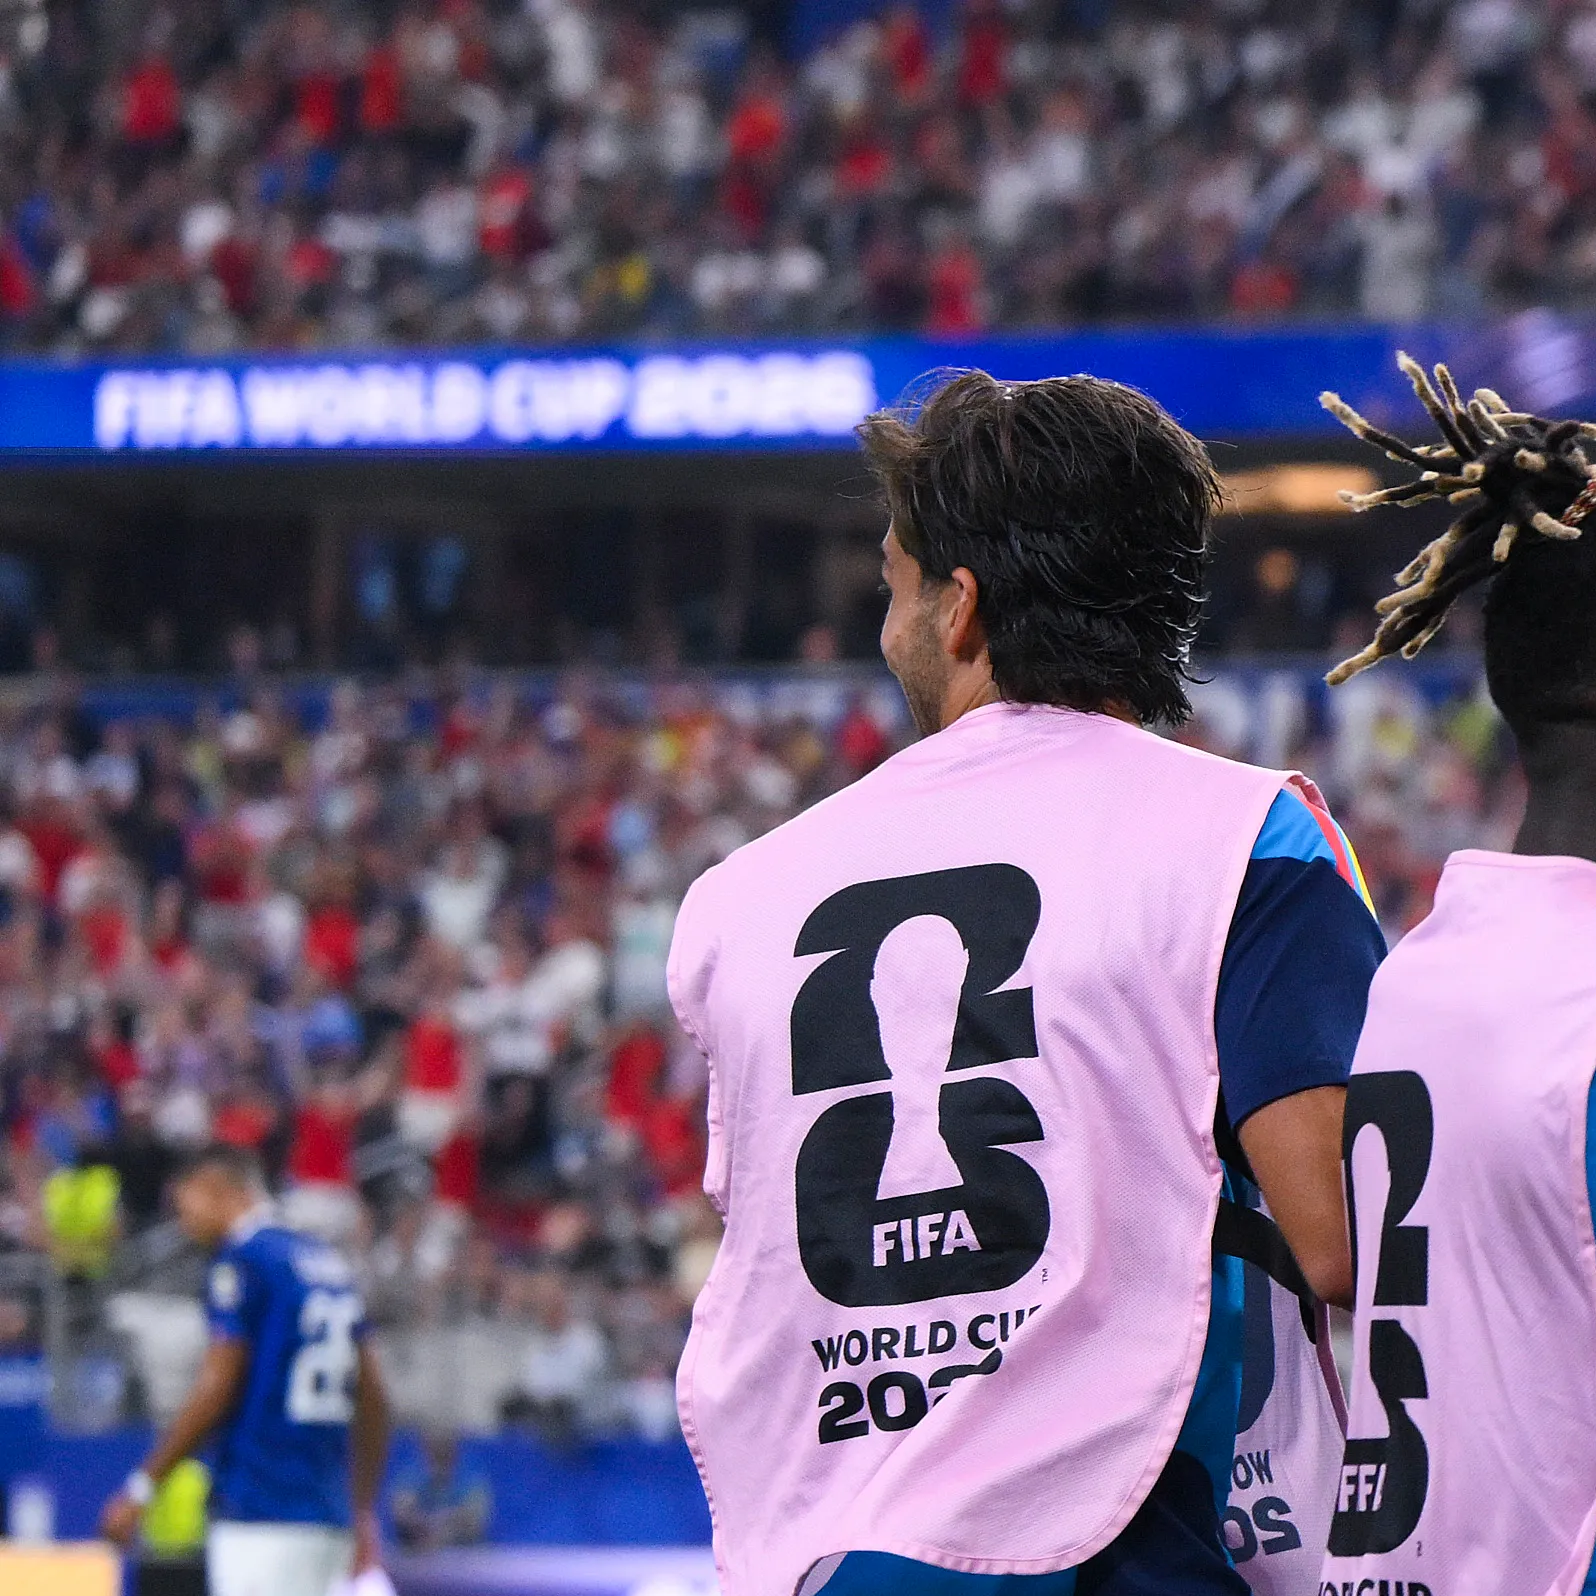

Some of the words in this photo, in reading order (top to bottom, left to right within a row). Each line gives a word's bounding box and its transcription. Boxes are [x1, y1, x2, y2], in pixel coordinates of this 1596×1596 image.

[93, 368, 240, 449] FIFA
[241, 361, 487, 446] WORLD
[487, 357, 629, 443] CUP
[872, 1208, 983, 1267] FIFA
[811, 1320, 957, 1373] WORLD
[967, 1304, 1043, 1351] CU
